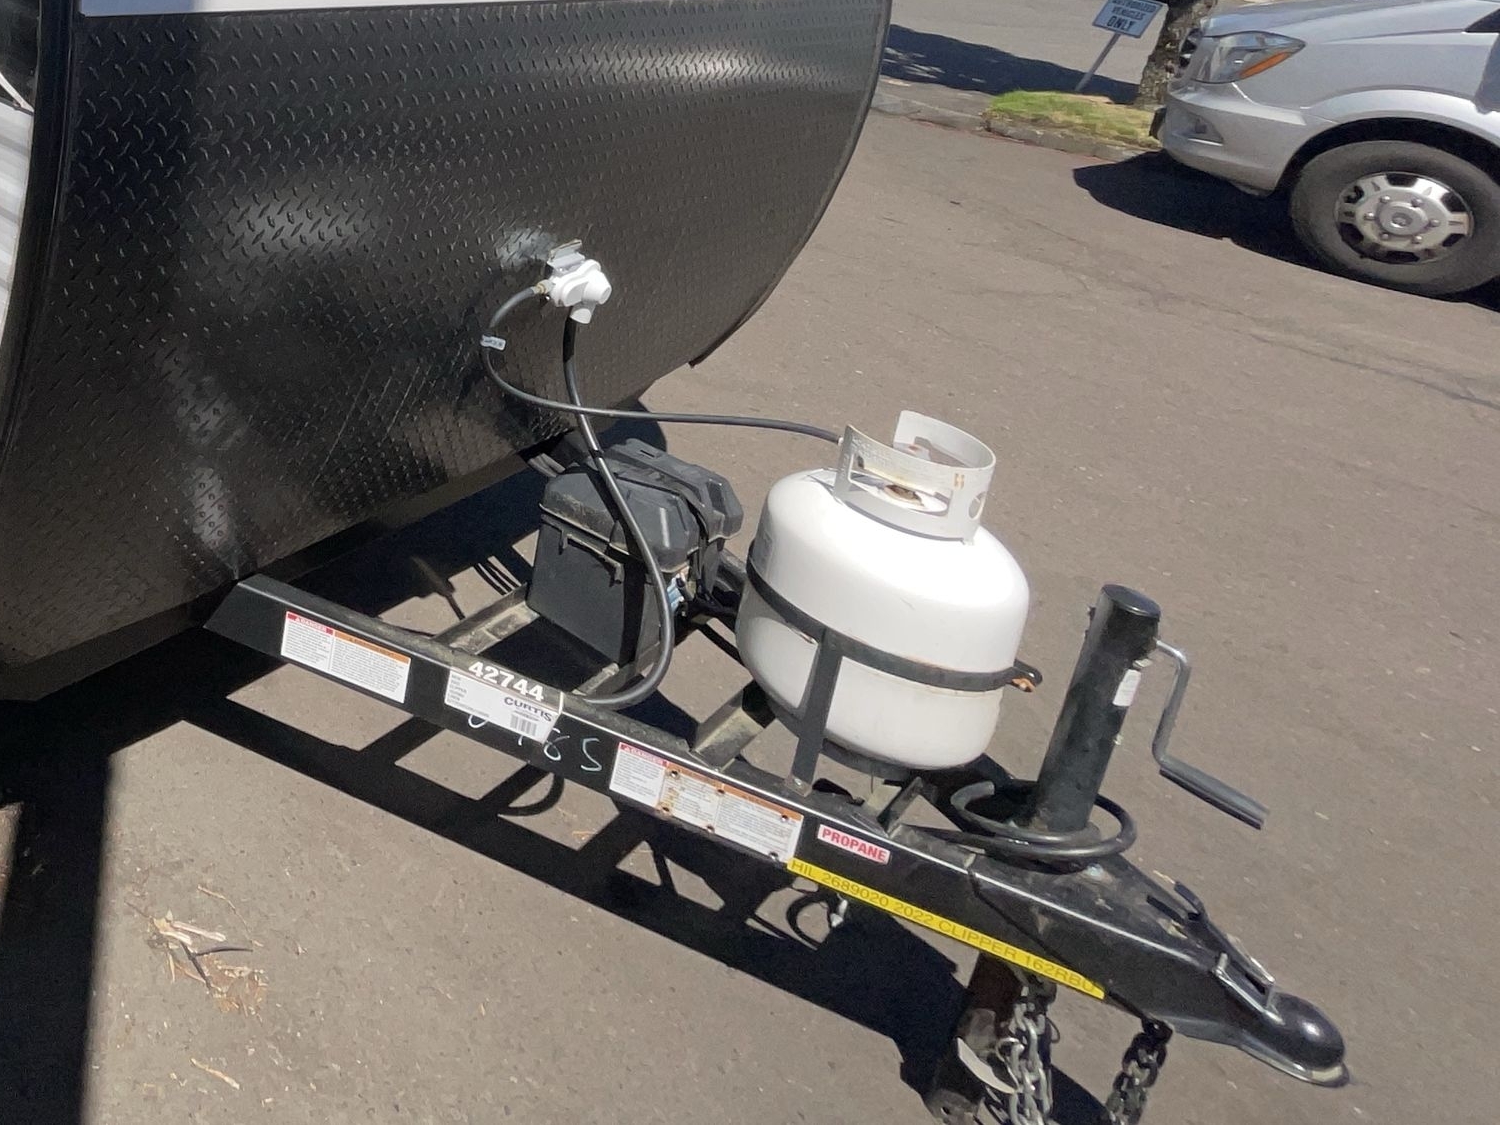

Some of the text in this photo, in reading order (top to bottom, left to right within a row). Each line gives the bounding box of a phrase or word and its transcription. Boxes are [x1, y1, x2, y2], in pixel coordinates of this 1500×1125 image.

[1106, 15, 1137, 32] ONLY
[468, 660, 545, 702] 42744
[503, 696, 553, 723] CURTIS
[821, 828, 888, 862] PROPANE
[791, 859, 813, 876] HIL
[820, 873, 890, 908] 2689020
[893, 900, 934, 924] 2022
[938, 920, 1017, 960] CLIPPER
